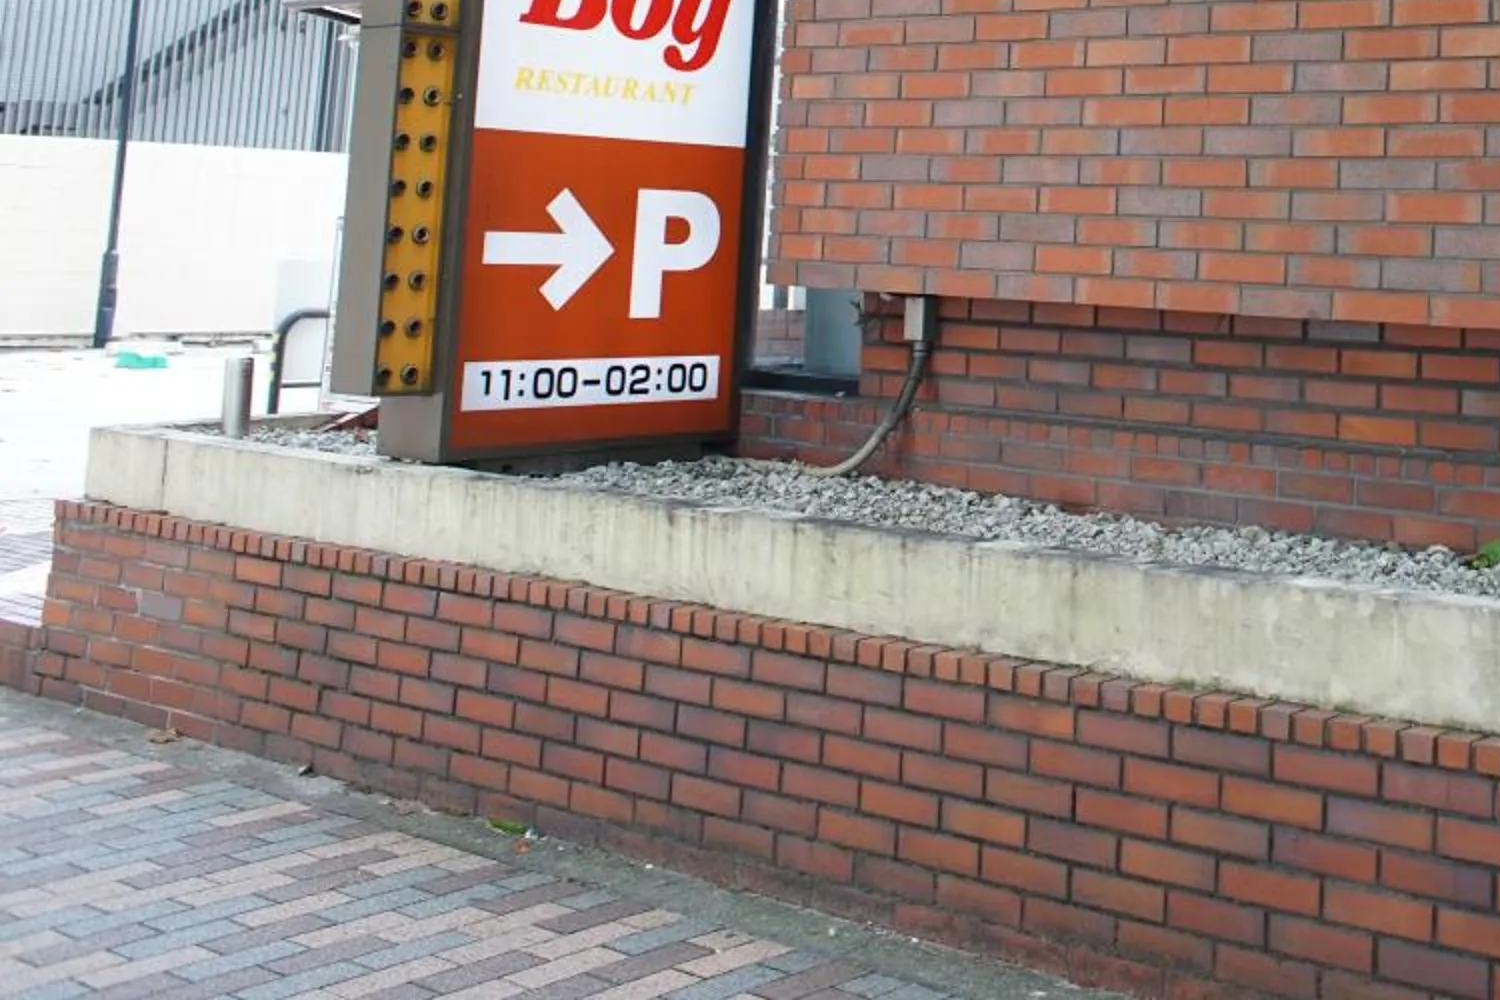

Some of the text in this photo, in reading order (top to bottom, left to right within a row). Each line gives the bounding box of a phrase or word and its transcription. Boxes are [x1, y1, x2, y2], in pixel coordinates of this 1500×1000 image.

[514, 64, 697, 106] RESTAURANT
[629, 187, 721, 319] P
[481, 362, 708, 401] 11:00-02:00
